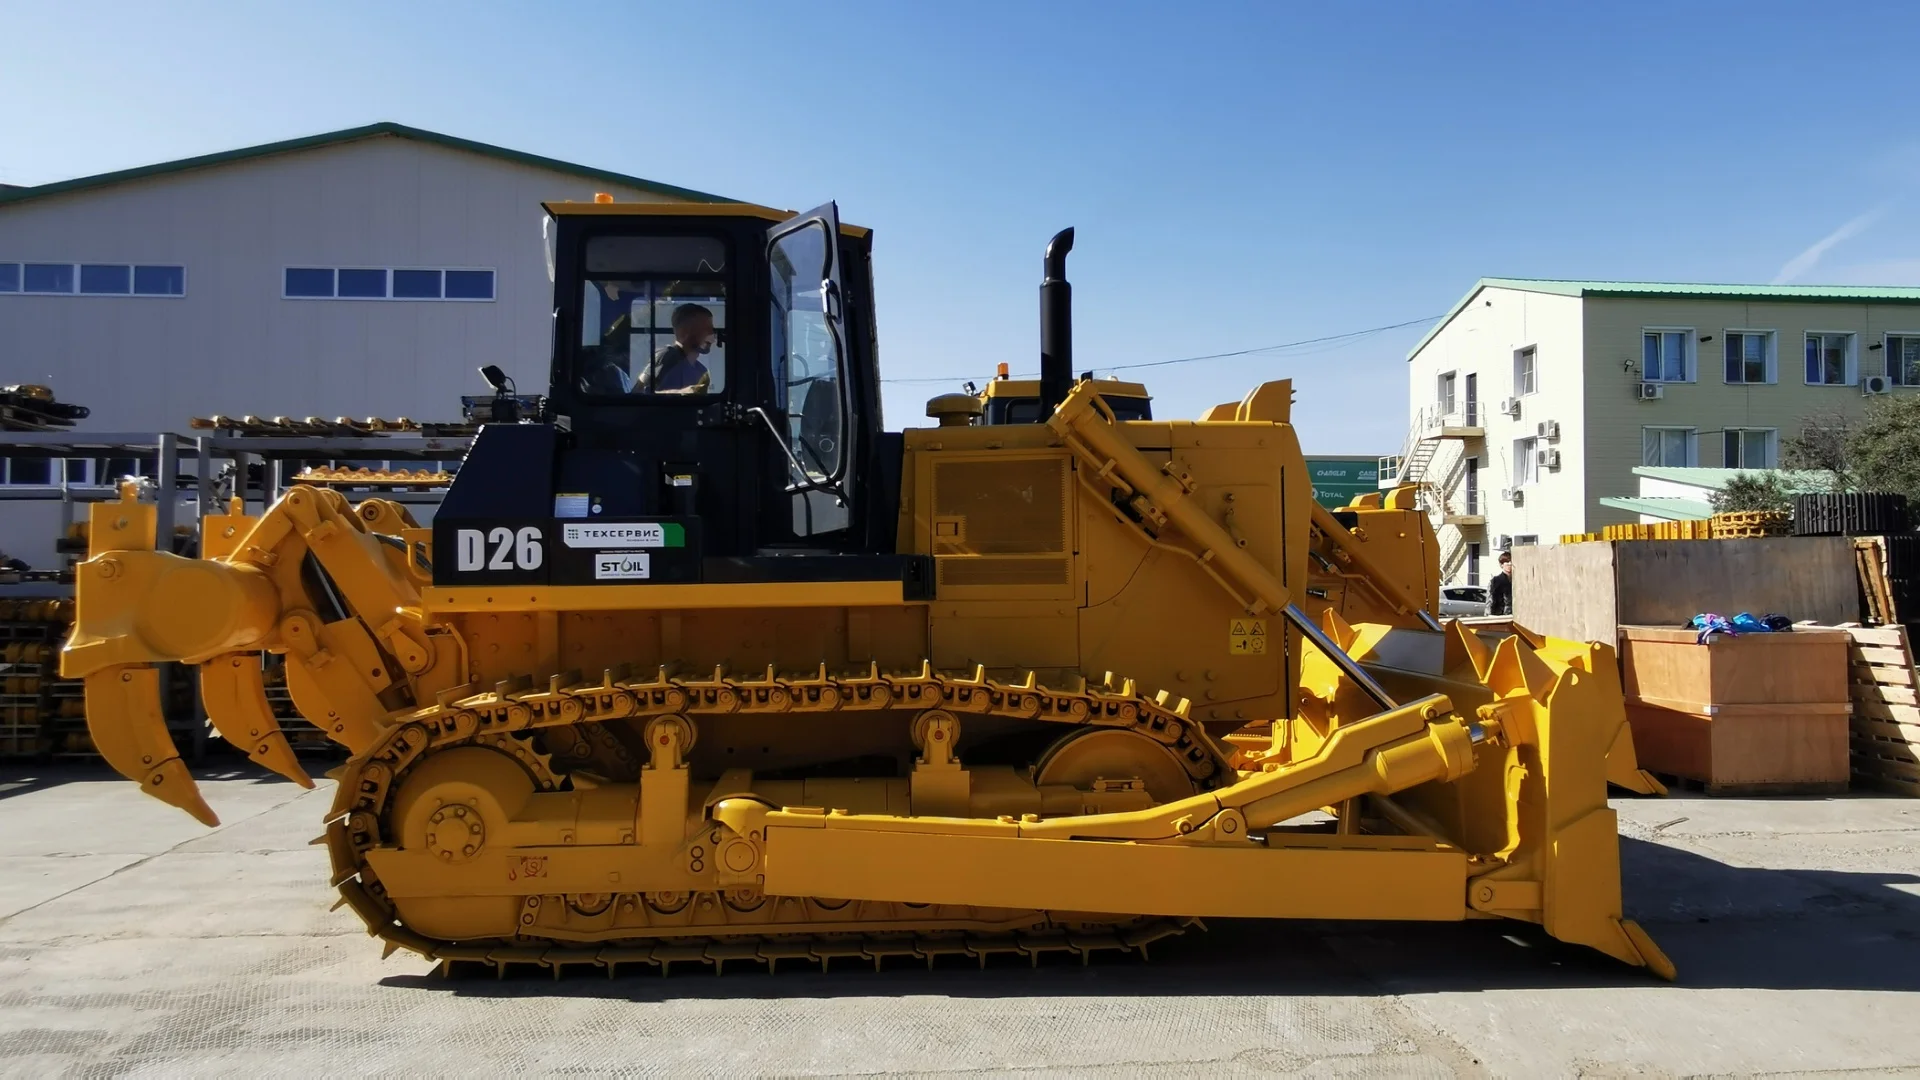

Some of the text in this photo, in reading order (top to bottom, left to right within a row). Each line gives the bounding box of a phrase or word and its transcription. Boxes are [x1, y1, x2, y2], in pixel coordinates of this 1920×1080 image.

[584, 530, 660, 538] ТЕХСЕРВИС
[457, 526, 543, 572] D26
[601, 556, 644, 573] STOIL
